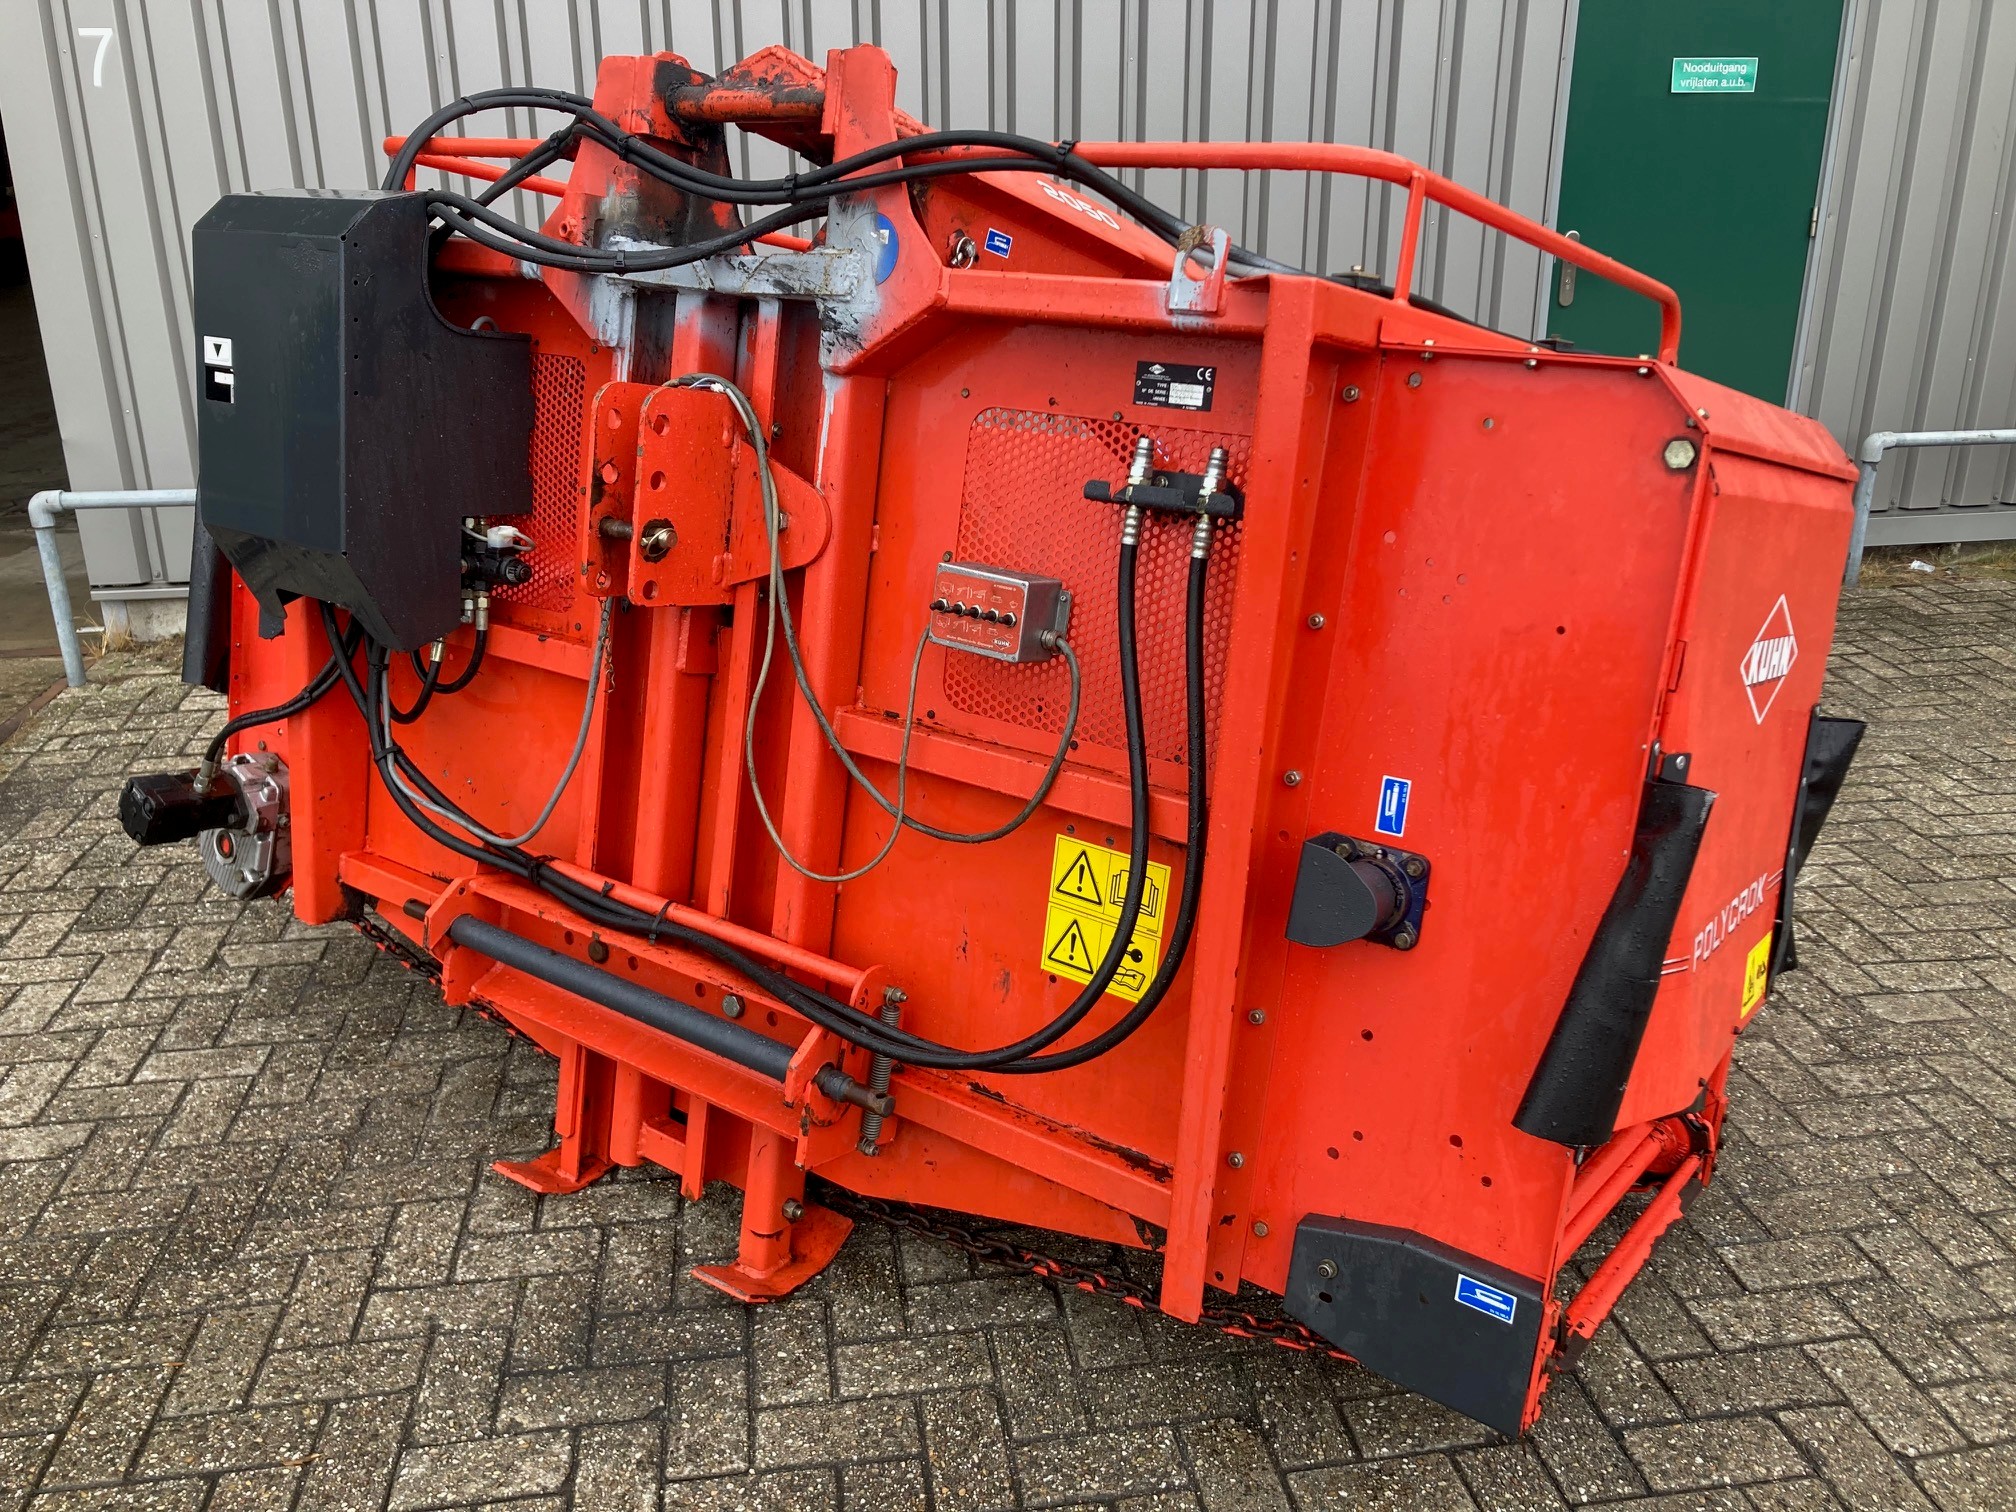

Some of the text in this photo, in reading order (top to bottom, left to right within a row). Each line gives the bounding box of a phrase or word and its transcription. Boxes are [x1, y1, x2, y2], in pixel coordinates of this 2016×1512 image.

[78, 27, 113, 87] 7
[1683, 62, 1747, 74] Nooduitgang
[1680, 77, 1746, 89] vrijlaten a.u.b.
[1036, 179, 1121, 230] 2050
[1196, 367, 1213, 381] CE
[1747, 635, 1794, 687] KUHN
[1692, 872, 1768, 973] POLYCROK
